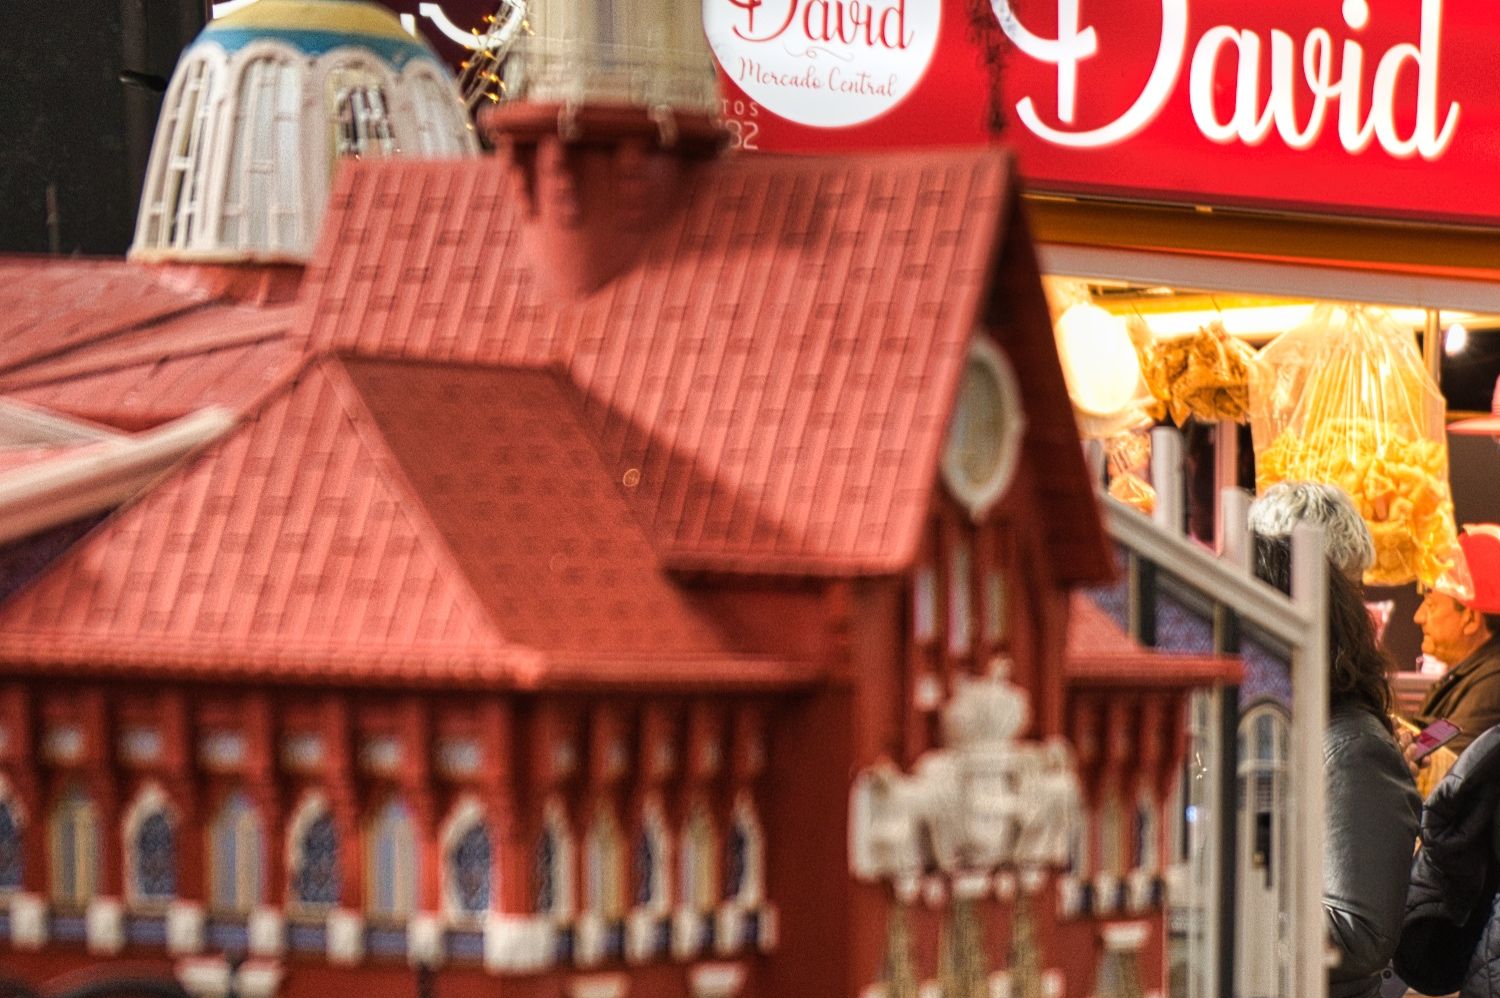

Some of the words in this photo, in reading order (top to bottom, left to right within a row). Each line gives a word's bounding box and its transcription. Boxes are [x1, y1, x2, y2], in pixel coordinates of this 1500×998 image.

[728, 0, 915, 50] David
[736, 56, 826, 89] Mercado
[828, 66, 898, 98] Central
[992, 0, 1460, 160] David
